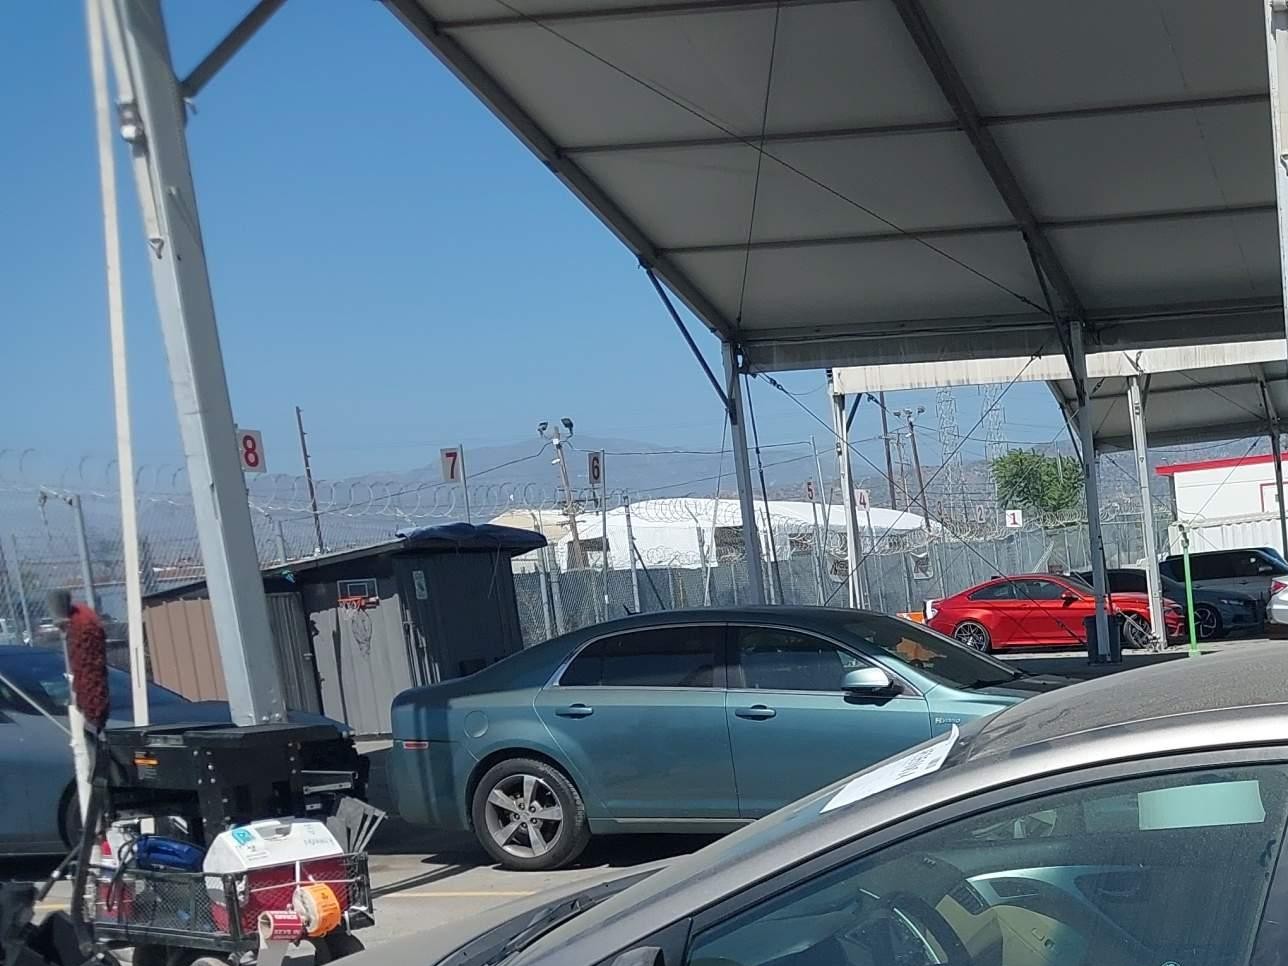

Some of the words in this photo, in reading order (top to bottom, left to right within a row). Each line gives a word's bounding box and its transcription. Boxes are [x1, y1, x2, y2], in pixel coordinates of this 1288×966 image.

[242, 434, 259, 468] 8
[445, 451, 457, 480] 7
[591, 456, 600, 480] 6
[807, 481, 814, 500] 5
[859, 491, 867, 509] 4
[977, 506, 984, 521] 2
[1010, 512, 1018, 525] 1
